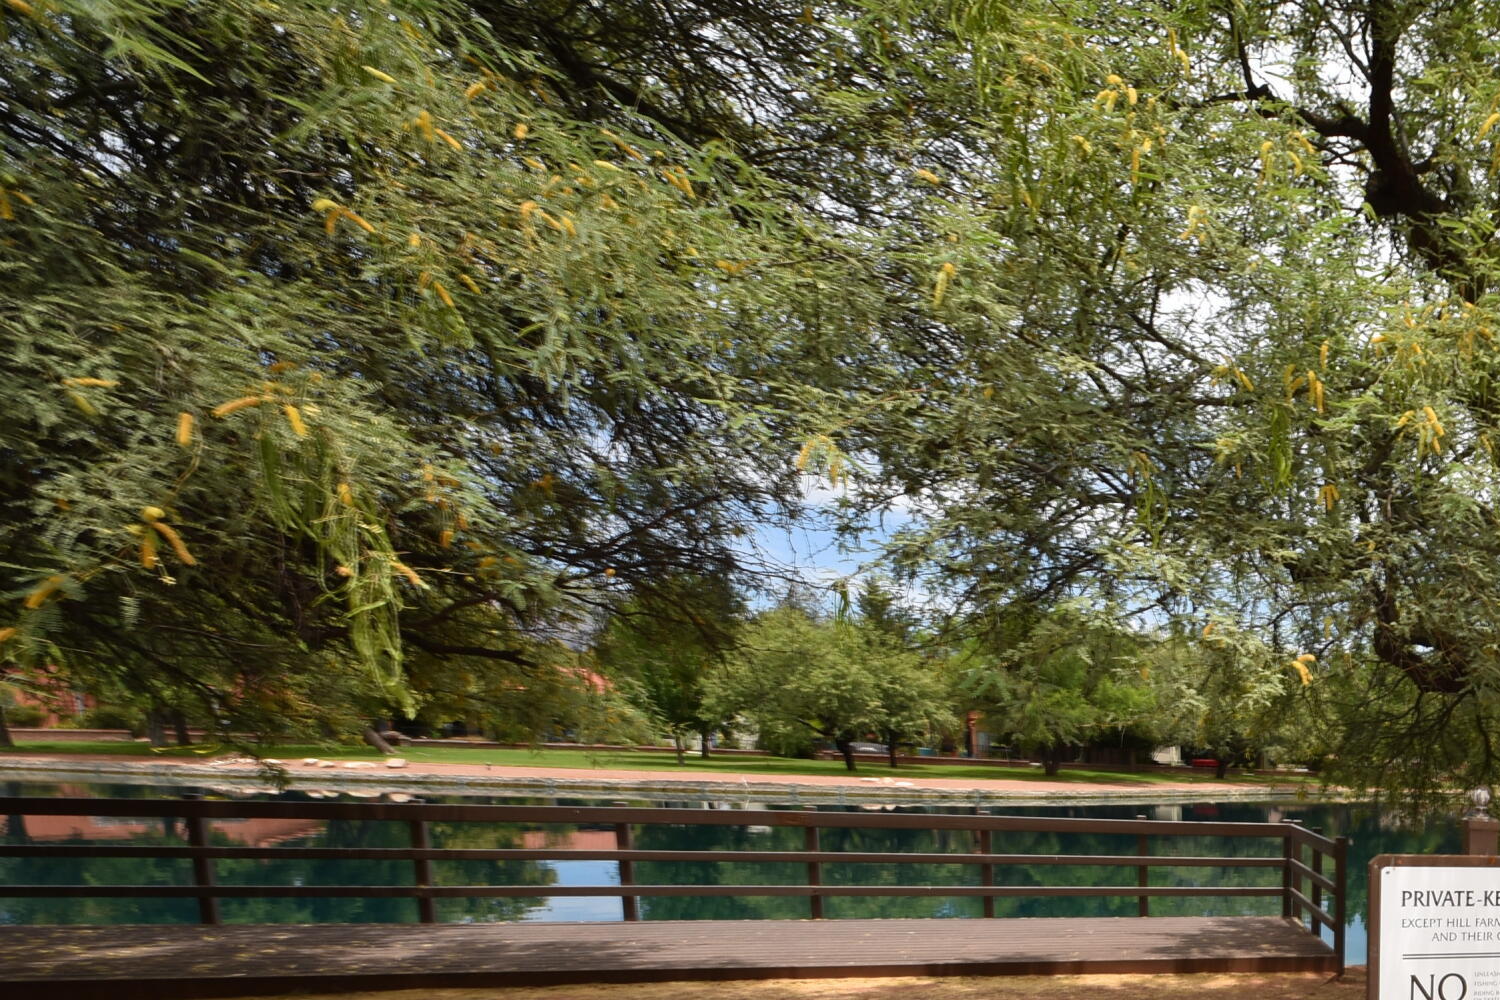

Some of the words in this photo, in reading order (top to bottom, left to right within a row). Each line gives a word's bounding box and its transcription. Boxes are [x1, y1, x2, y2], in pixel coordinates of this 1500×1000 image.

[1401, 918, 1442, 928] EXCEPT
[1446, 918, 1471, 928] HILL
[1431, 931, 1458, 942] AND
[1462, 931, 1493, 941] THEIR
